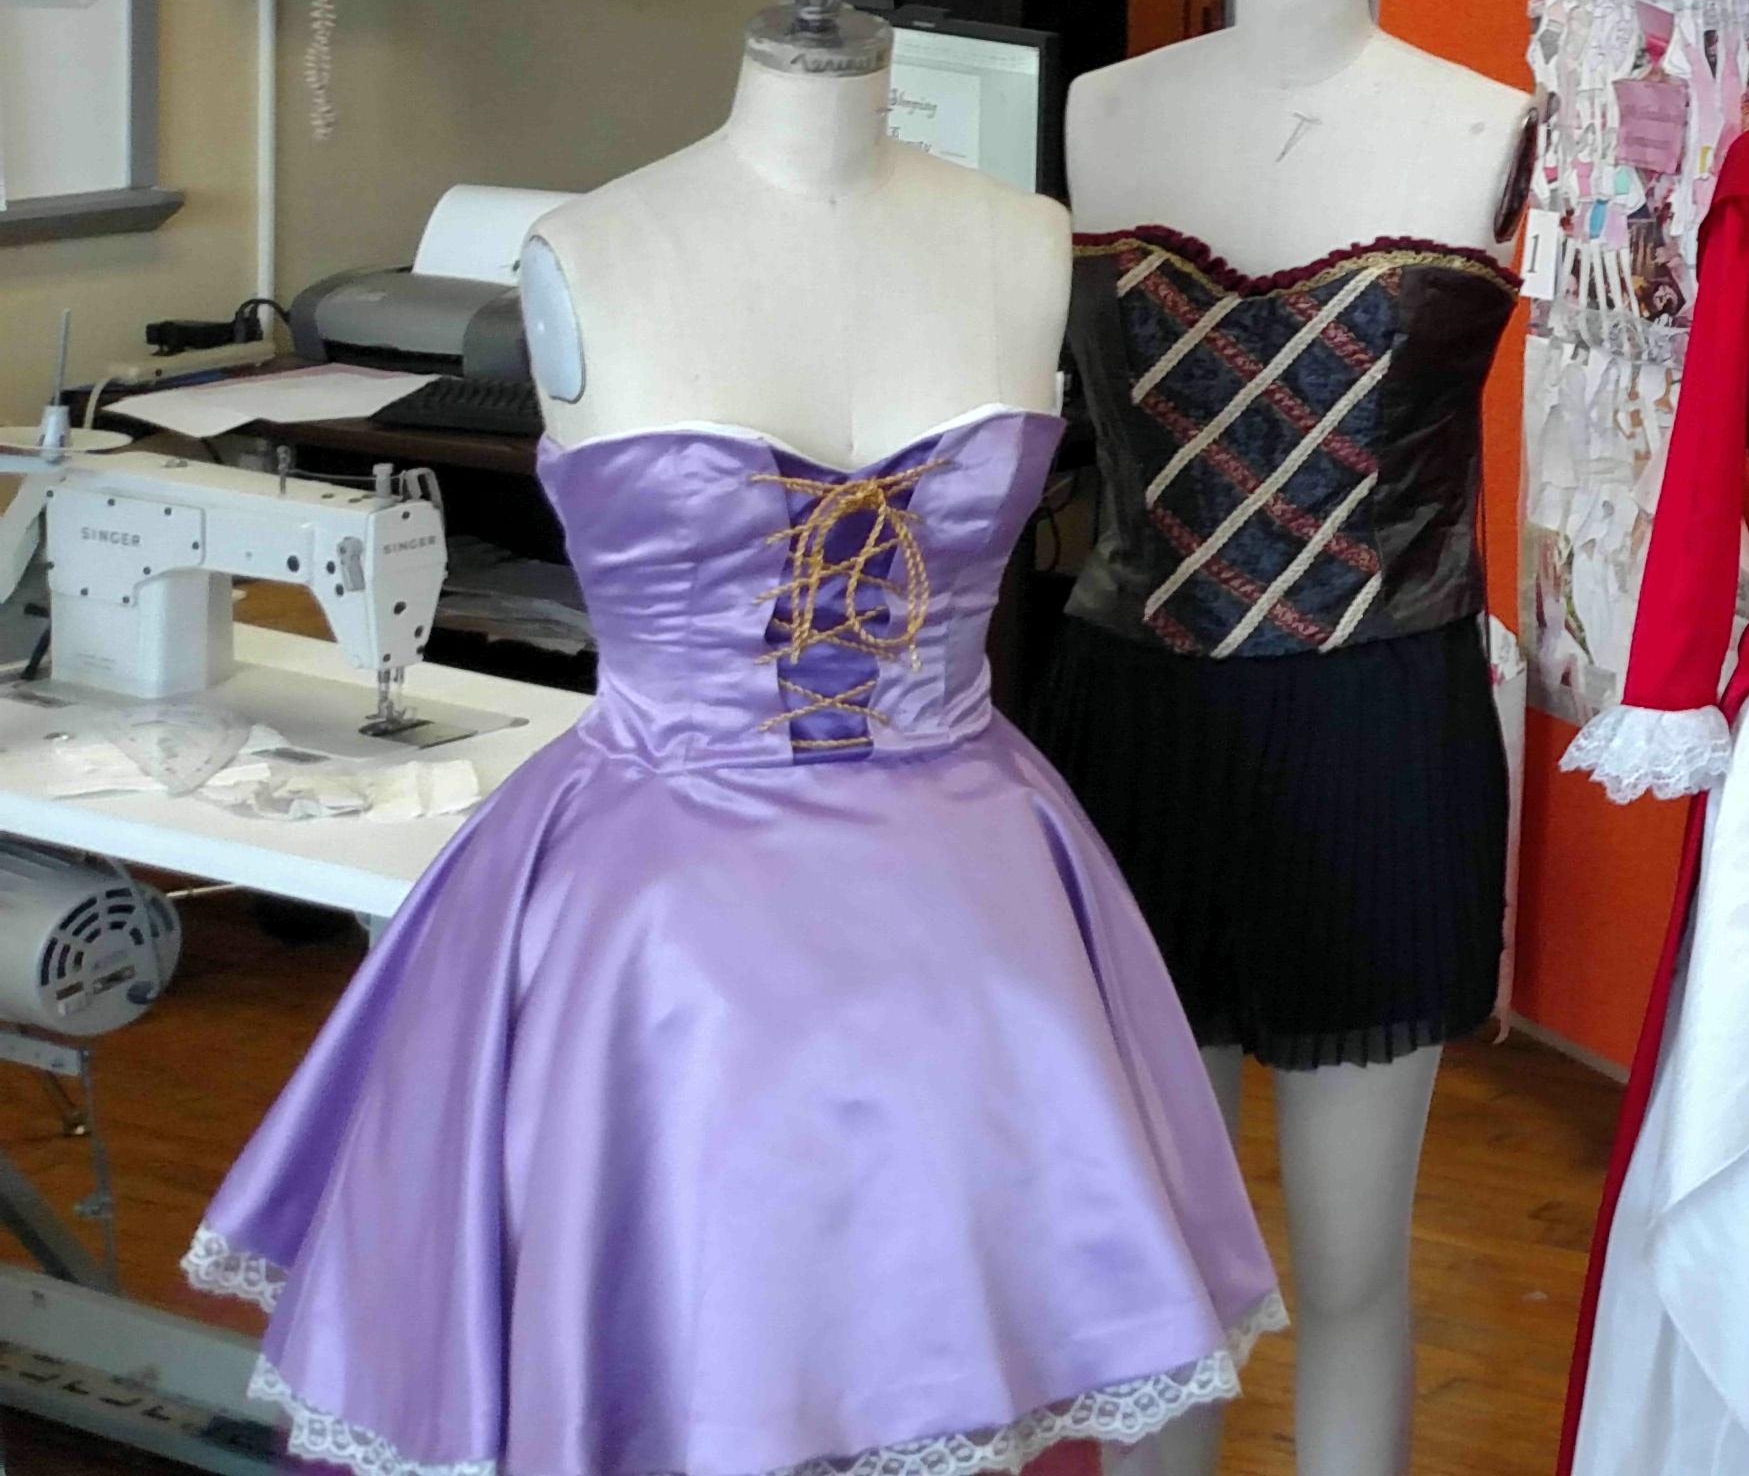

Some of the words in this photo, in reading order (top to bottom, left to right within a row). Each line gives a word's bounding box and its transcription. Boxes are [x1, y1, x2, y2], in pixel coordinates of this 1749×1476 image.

[1525, 232, 1541, 275] 1
[80, 525, 142, 548] SINGER
[383, 534, 437, 556] SINGER
